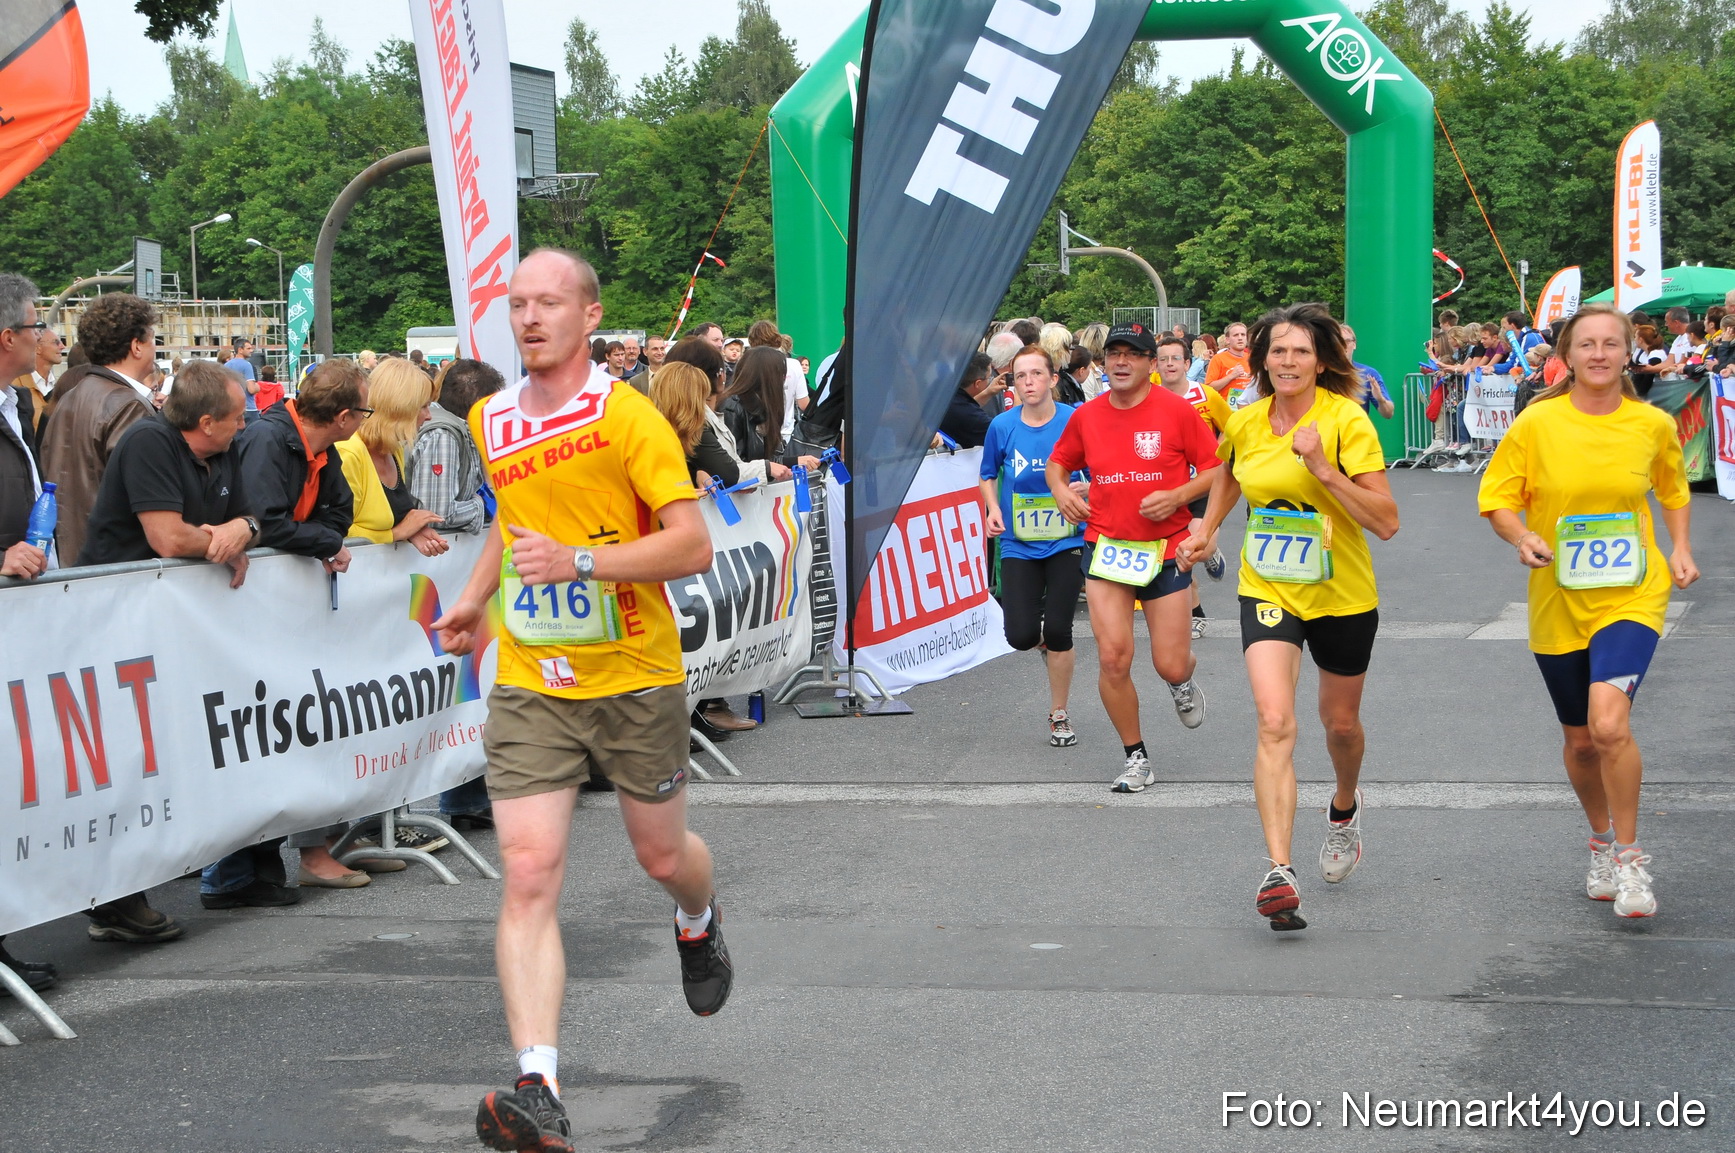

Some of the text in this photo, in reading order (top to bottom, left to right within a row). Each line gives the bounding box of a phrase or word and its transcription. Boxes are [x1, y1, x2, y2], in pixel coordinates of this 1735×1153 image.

[1279, 12, 1403, 116] AOK
[1646, 153, 1658, 228] www.klebl.de
[492, 430, 611, 492] MAX BÖGL
[1032, 459, 1047, 467] PL
[1096, 471, 1163, 485] Stadt-Team
[1017, 510, 1066, 528] 1171
[1101, 545, 1150, 573] 935
[1254, 533, 1314, 565] 777
[1566, 538, 1632, 570] 782
[867, 501, 989, 633] MEIER
[1255, 562, 1287, 571] Adelheid
[1569, 570, 1604, 578] Michaela
[513, 580, 592, 619] 416
[1260, 608, 1280, 620] FC
[524, 620, 563, 630] Andreas
[202, 661, 456, 770] Frischmann
[7, 654, 159, 810] INT
[354, 742, 408, 780] Druck
